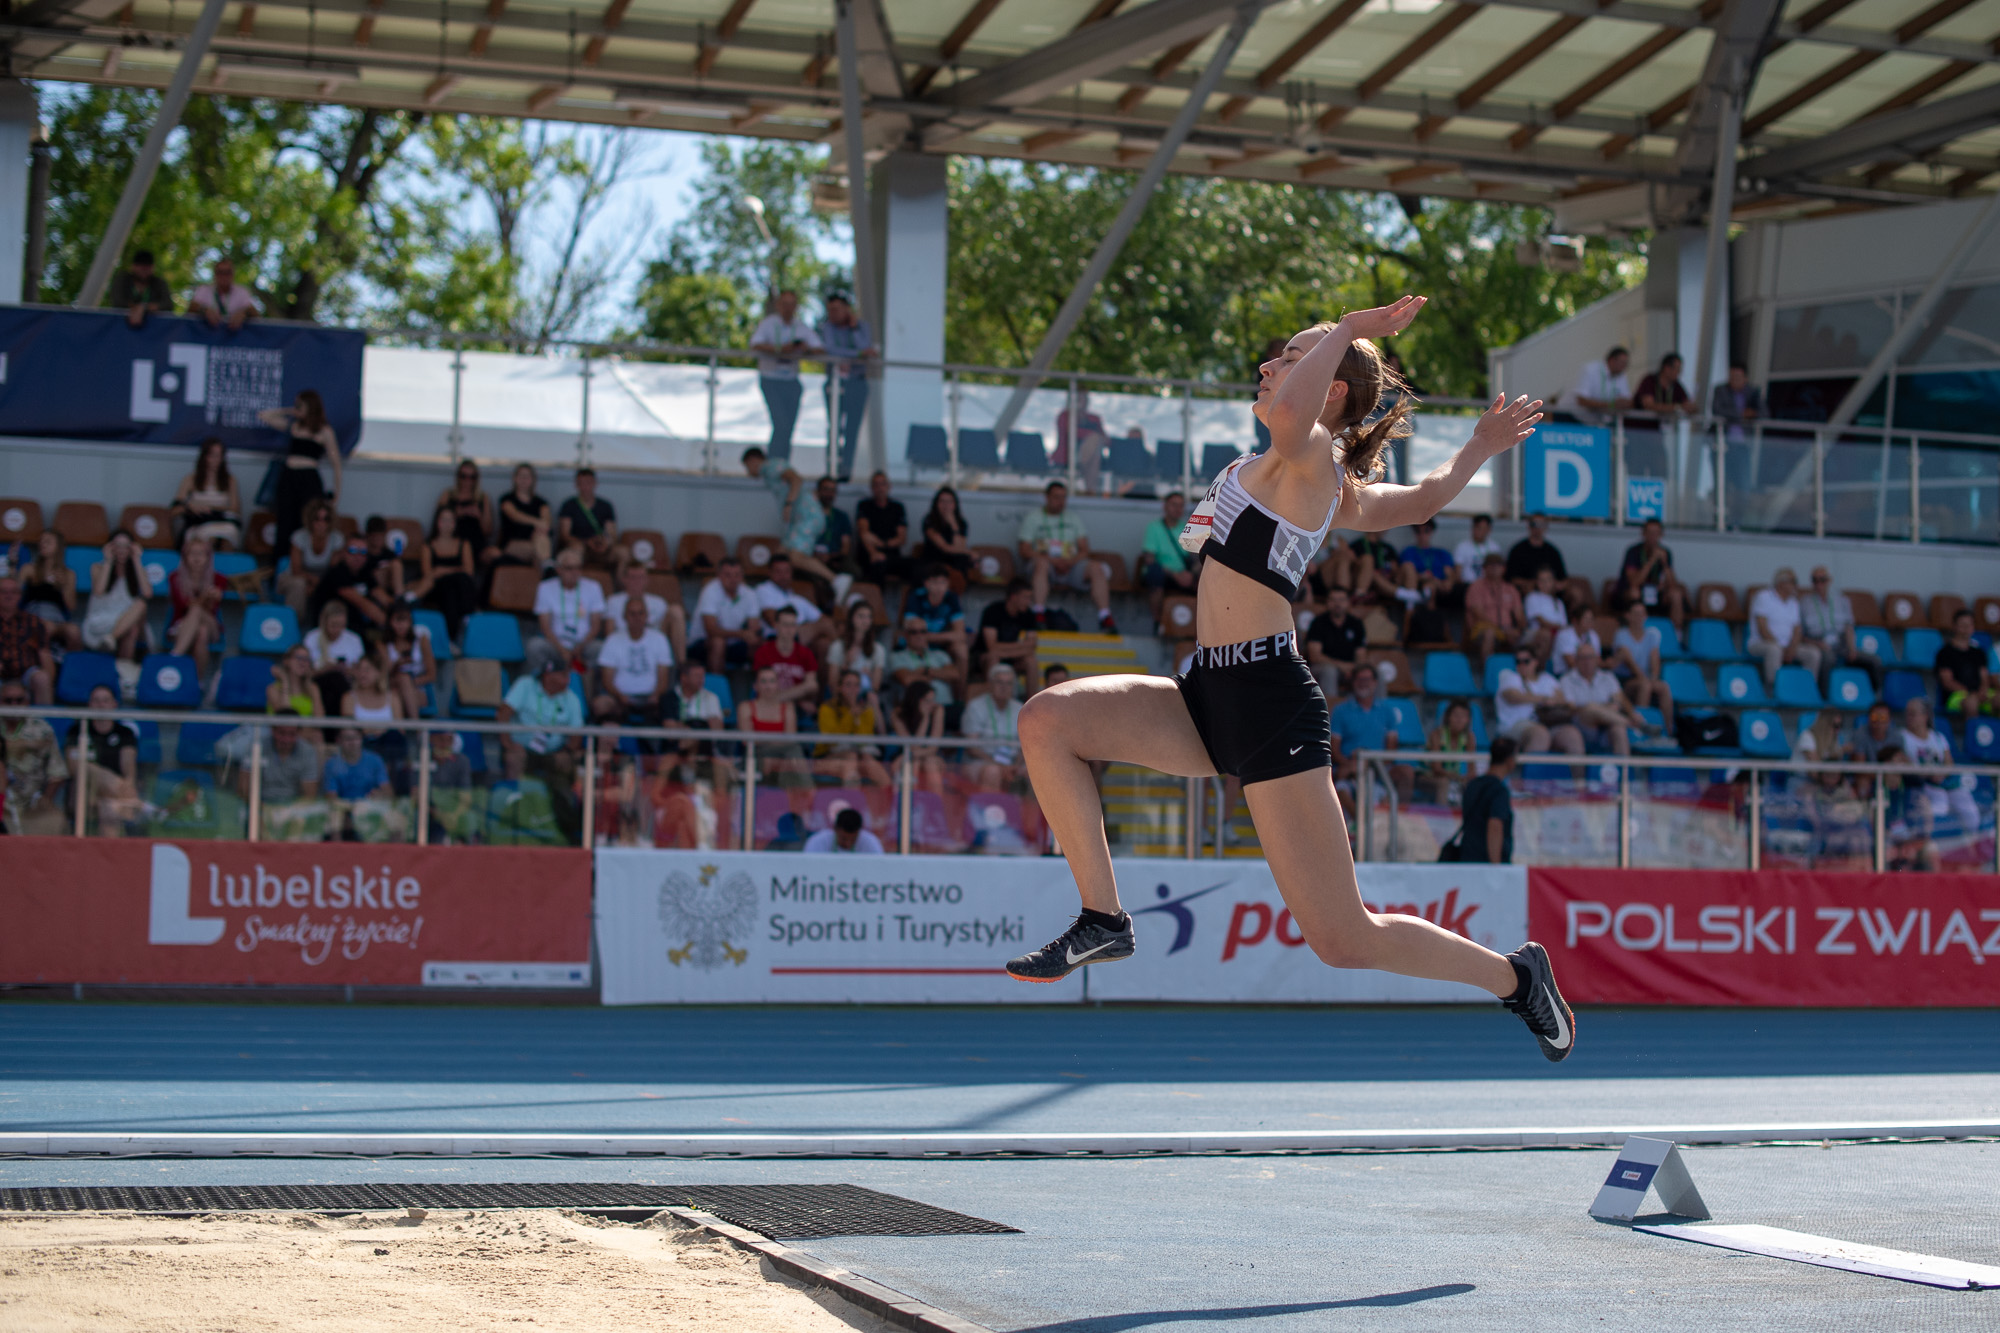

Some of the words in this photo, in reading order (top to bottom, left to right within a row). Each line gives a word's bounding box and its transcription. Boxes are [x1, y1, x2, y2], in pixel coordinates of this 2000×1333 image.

[1544, 449, 1594, 509] D
[1630, 485, 1664, 506] WC
[1209, 637, 1268, 669] NIKE
[770, 875, 963, 904] Ministerstwo
[769, 914, 868, 945] Sportu
[876, 915, 883, 941] i
[894, 914, 1025, 947] Turystyki
[1566, 902, 1796, 955] POLSKI
